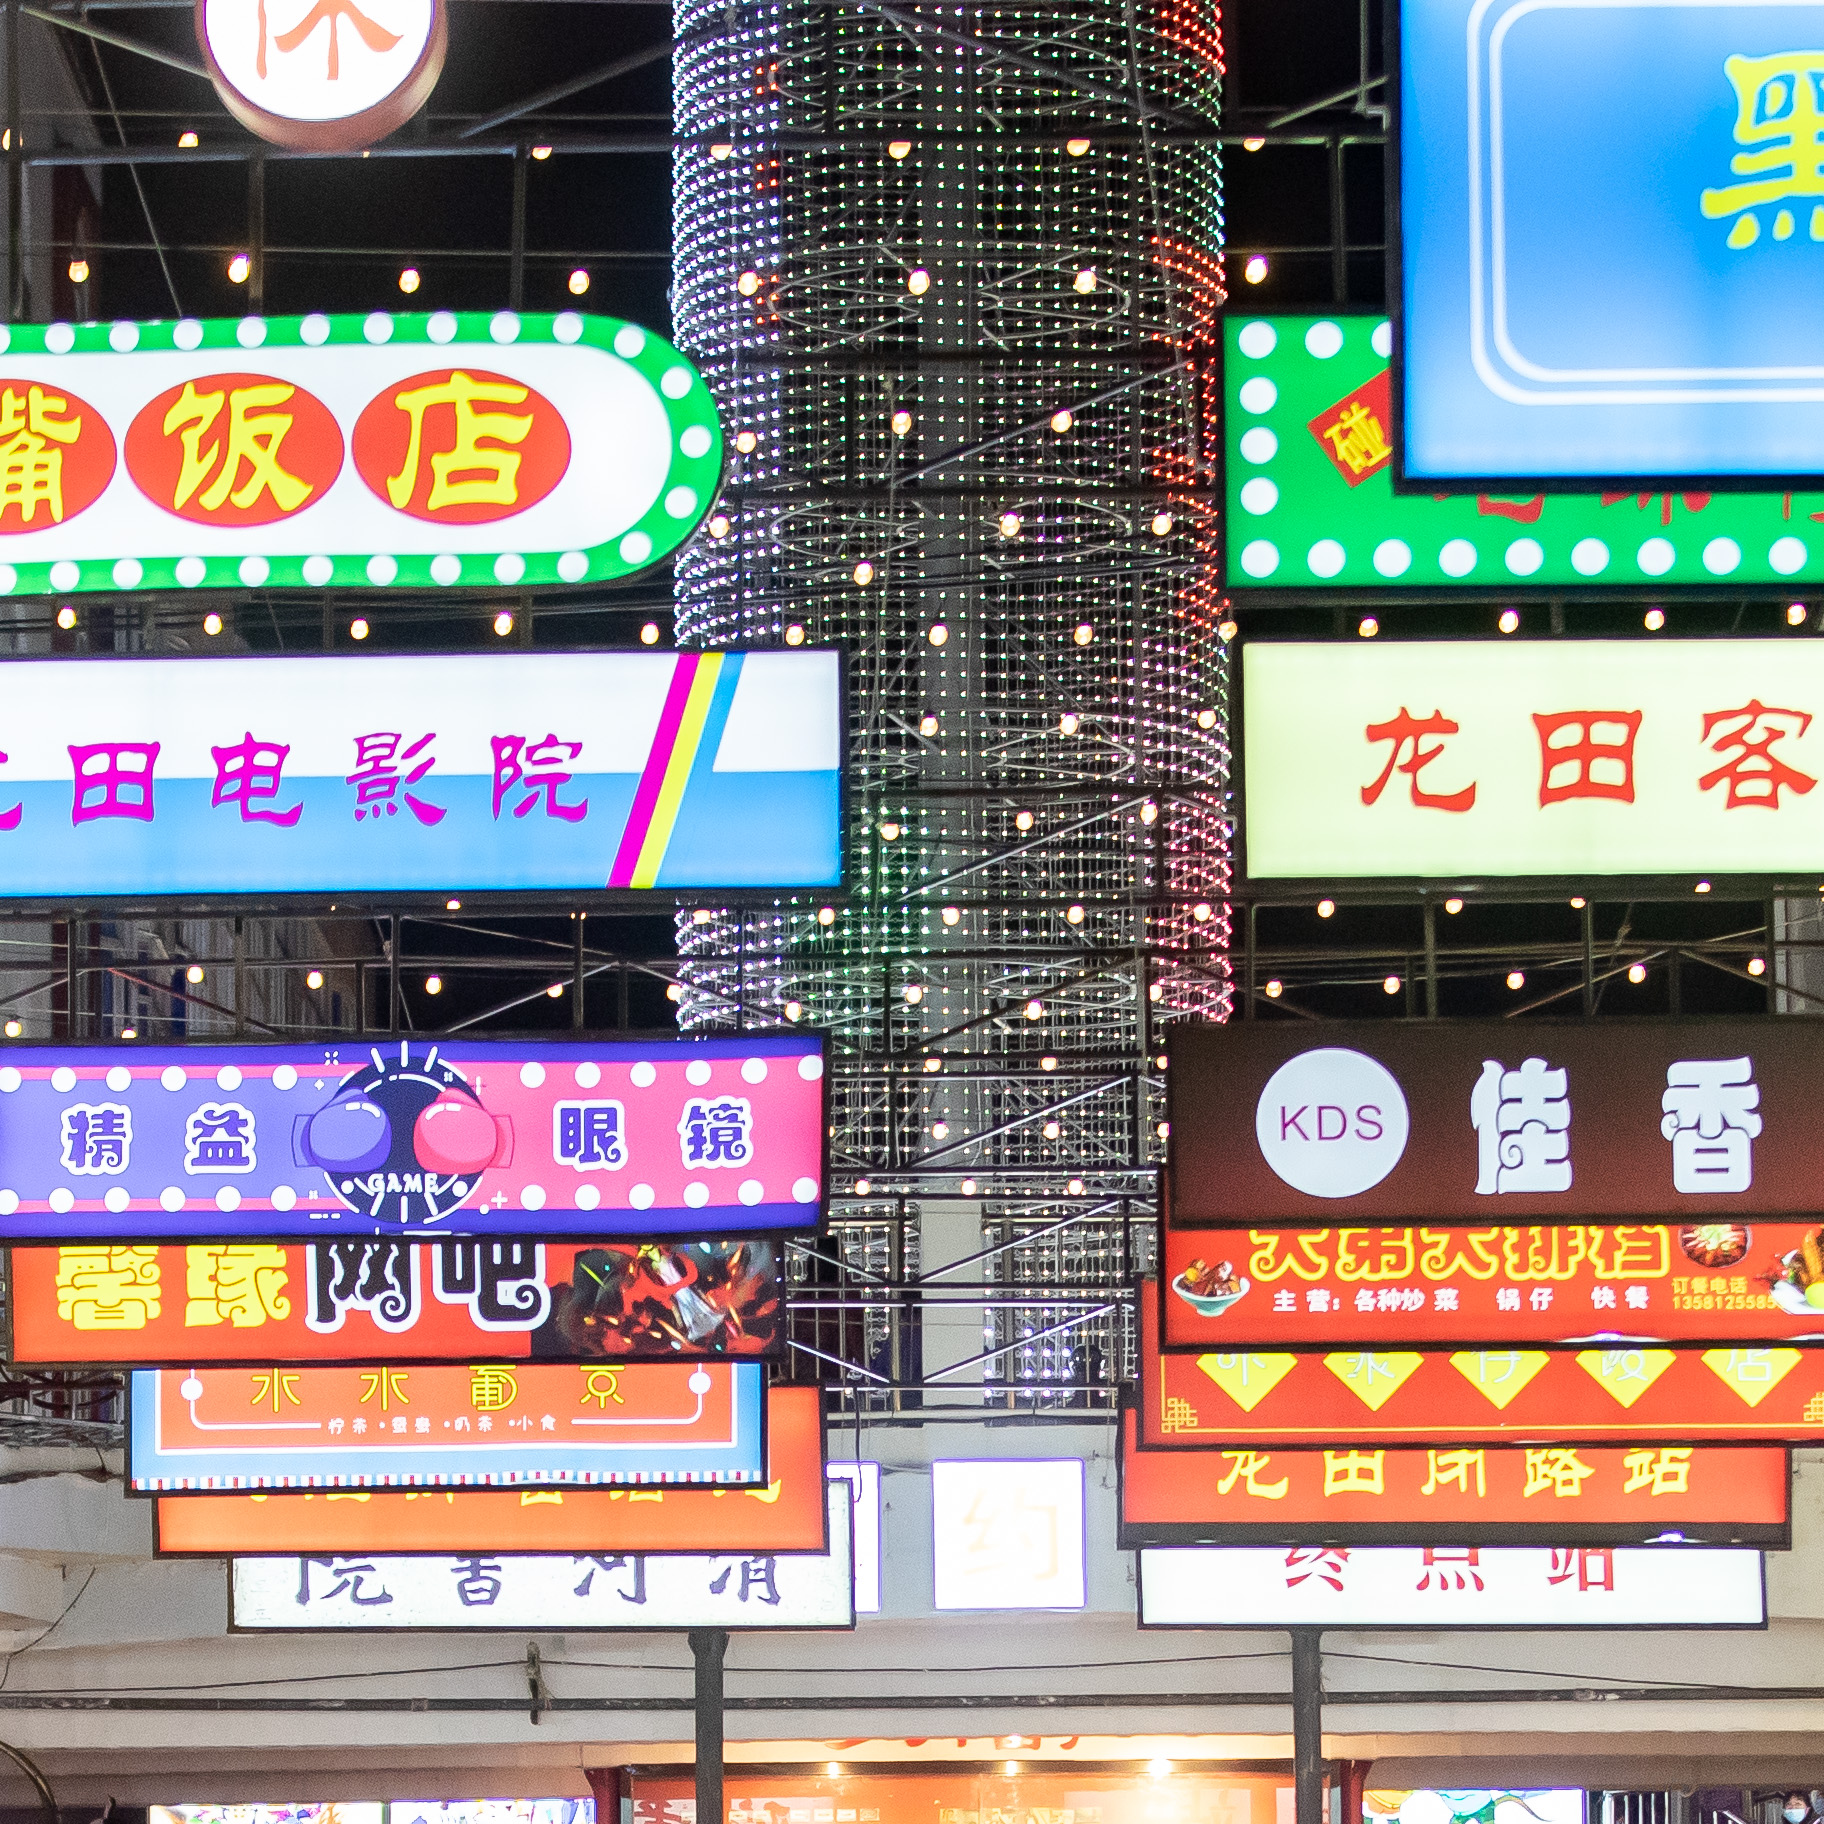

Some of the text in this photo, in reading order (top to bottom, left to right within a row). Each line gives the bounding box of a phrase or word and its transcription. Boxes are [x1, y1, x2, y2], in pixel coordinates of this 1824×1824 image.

[552, 1096, 754, 1173] 眼镜
[1278, 1104, 1384, 1142] KDS
[368, 1172, 439, 1194] GAME
[1590, 1285, 1650, 1311] 快餐
[1672, 1276, 1747, 1295] 订餐电话
